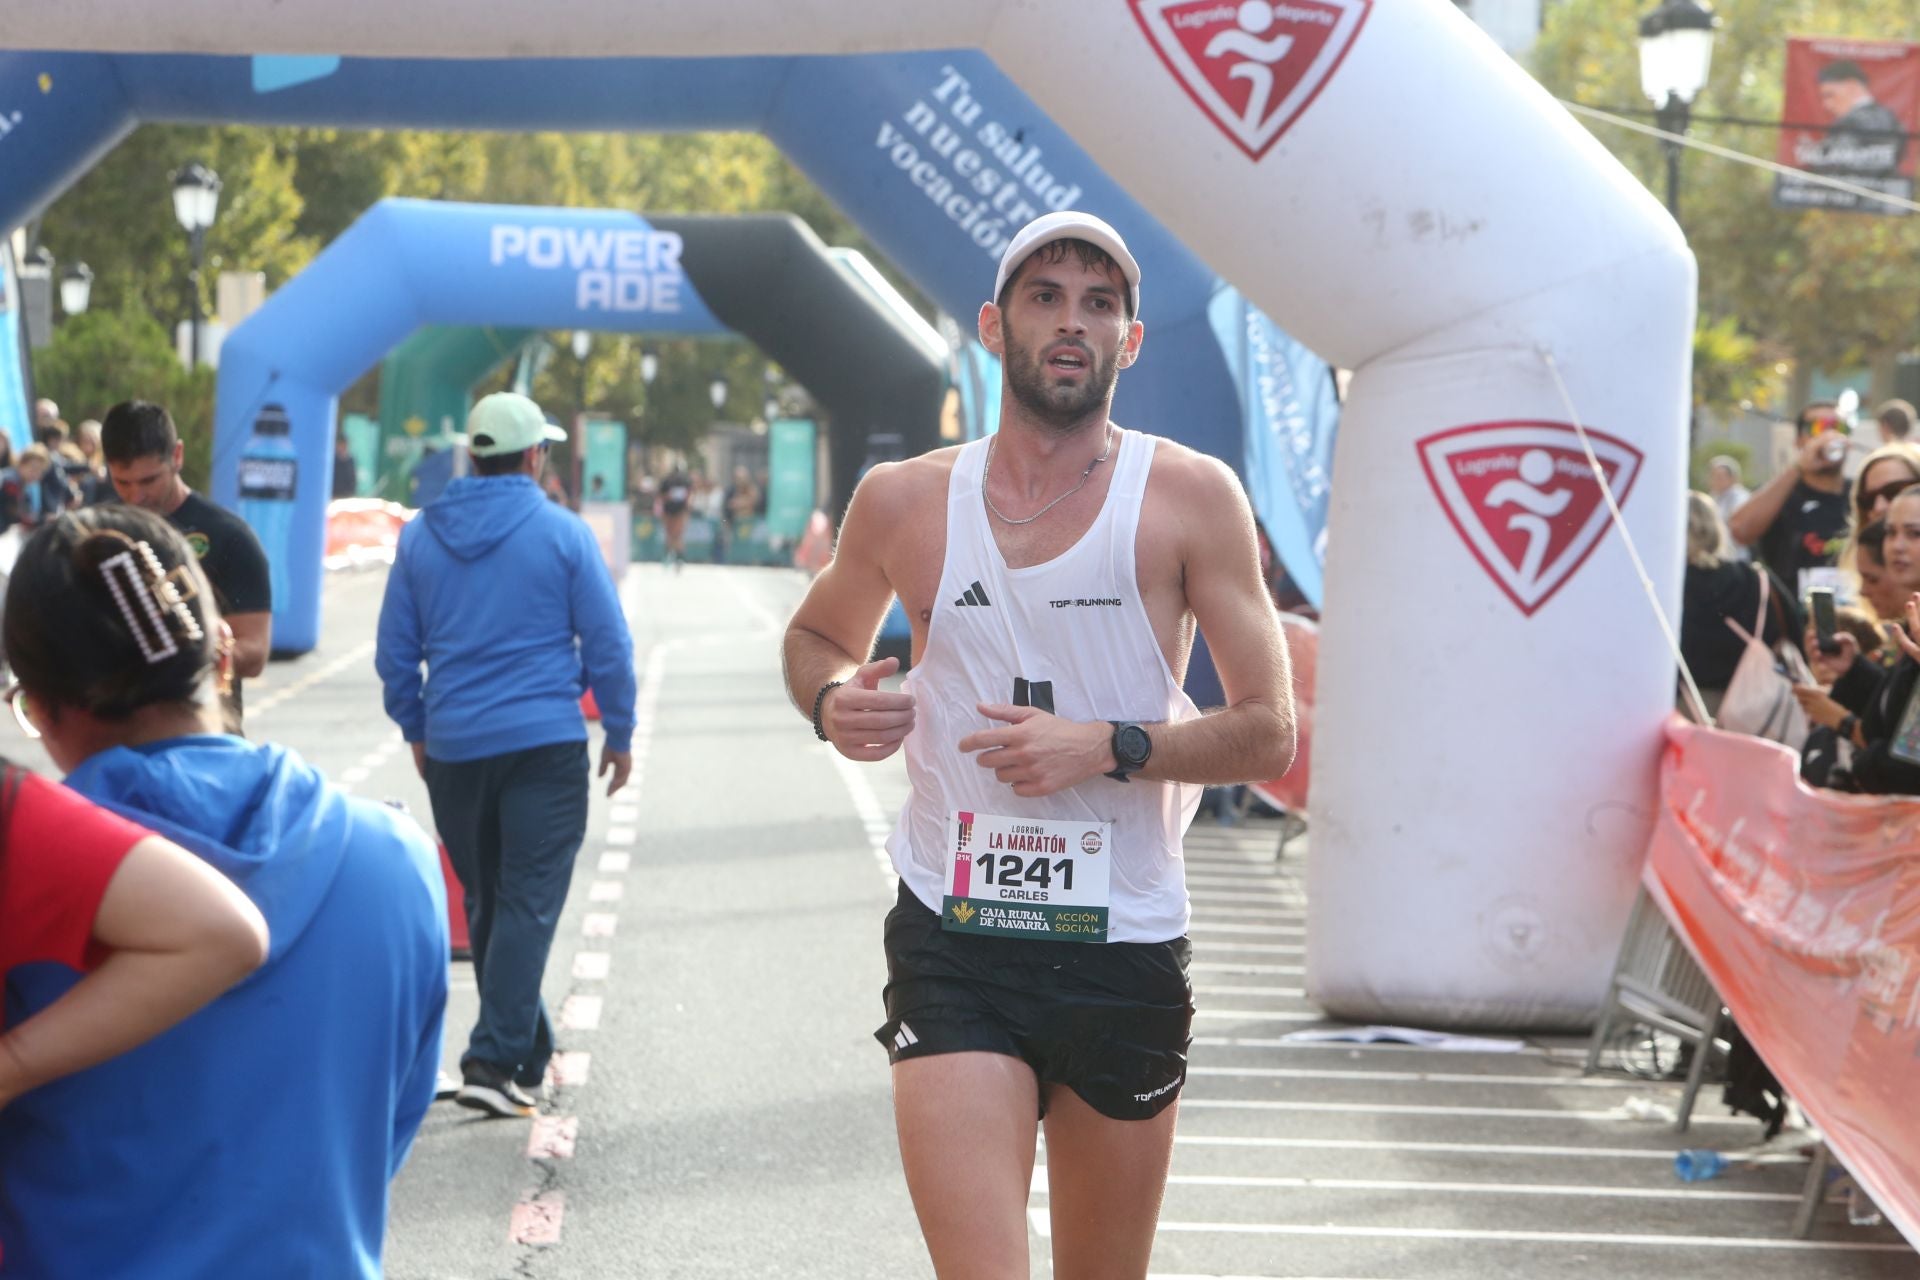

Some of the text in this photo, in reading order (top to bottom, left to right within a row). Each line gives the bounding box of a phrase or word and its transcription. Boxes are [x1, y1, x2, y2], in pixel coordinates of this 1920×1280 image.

[932, 64, 1083, 212] Tu salud
[902, 99, 1038, 225] nuestr
[490, 224, 684, 271] POWER
[577, 270, 682, 313] ADE
[1556, 455, 1610, 482] depor
[1011, 825, 1044, 835] LOGROÑO
[989, 832, 1066, 854] LA MARATÓN
[956, 853, 971, 862] 21K
[976, 853, 1073, 890] 1241
[1000, 888, 1049, 901] CARLES
[980, 907, 1046, 921] CAJA RURAL
[1055, 912, 1098, 923] ACCIÓN
[979, 918, 1050, 931] DE NAVARRA
[1055, 924, 1097, 934] SOCIAL
